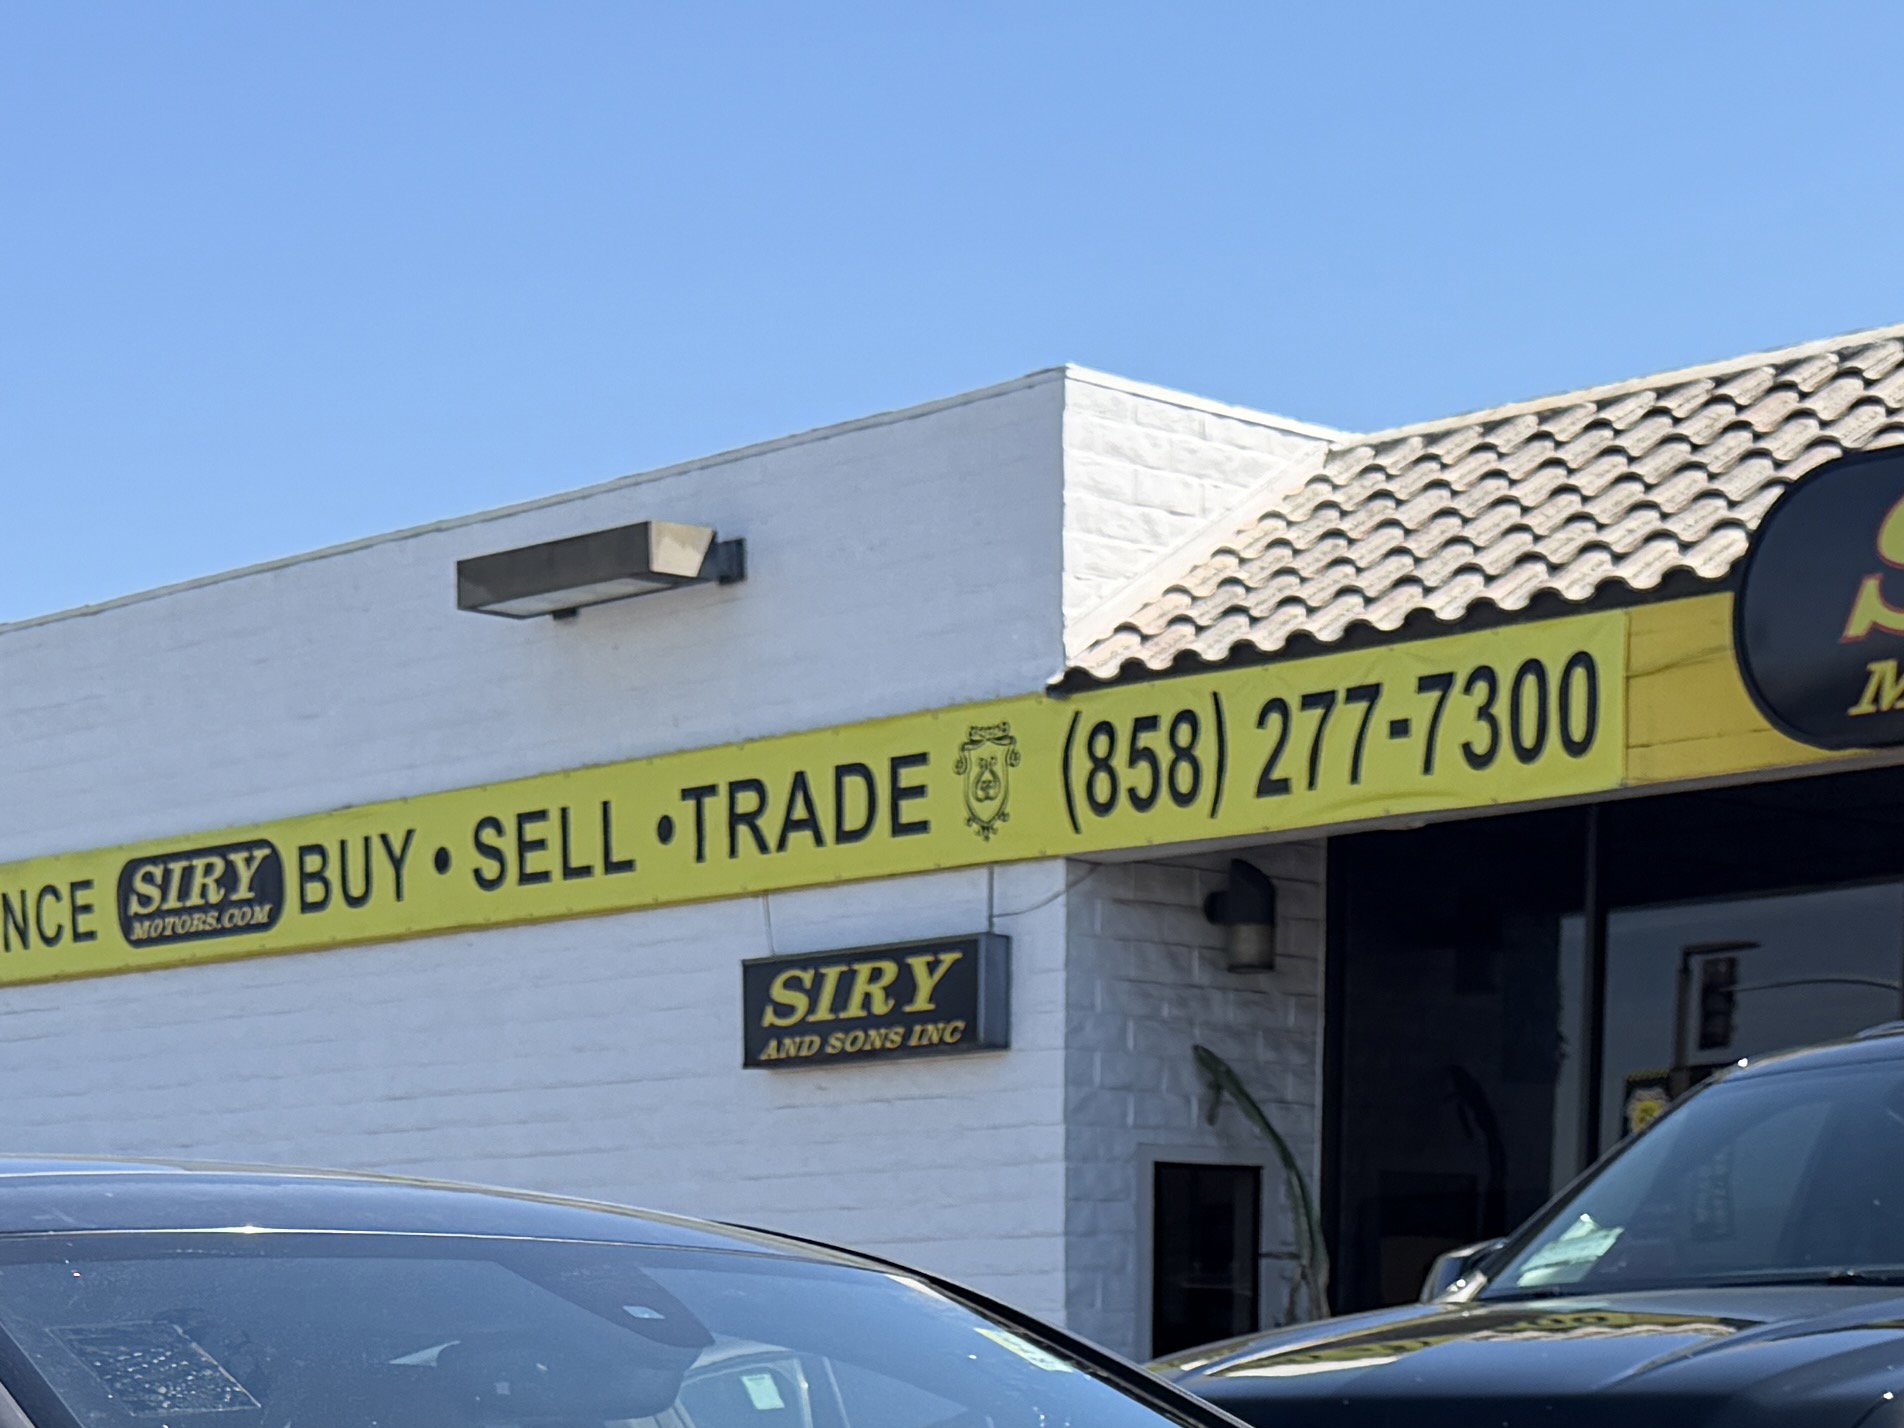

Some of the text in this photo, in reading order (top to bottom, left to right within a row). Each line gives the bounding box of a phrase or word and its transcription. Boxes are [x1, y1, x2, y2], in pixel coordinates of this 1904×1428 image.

[1061, 651, 1600, 834] (858) 277-7300
[299, 752, 931, 913] BUY SELL TRADE
[129, 838, 271, 916] SIRY
[131, 902, 272, 941] MOTORS.COM
[761, 950, 963, 1027] SIRY
[761, 1019, 967, 1061] AND SONS INC
